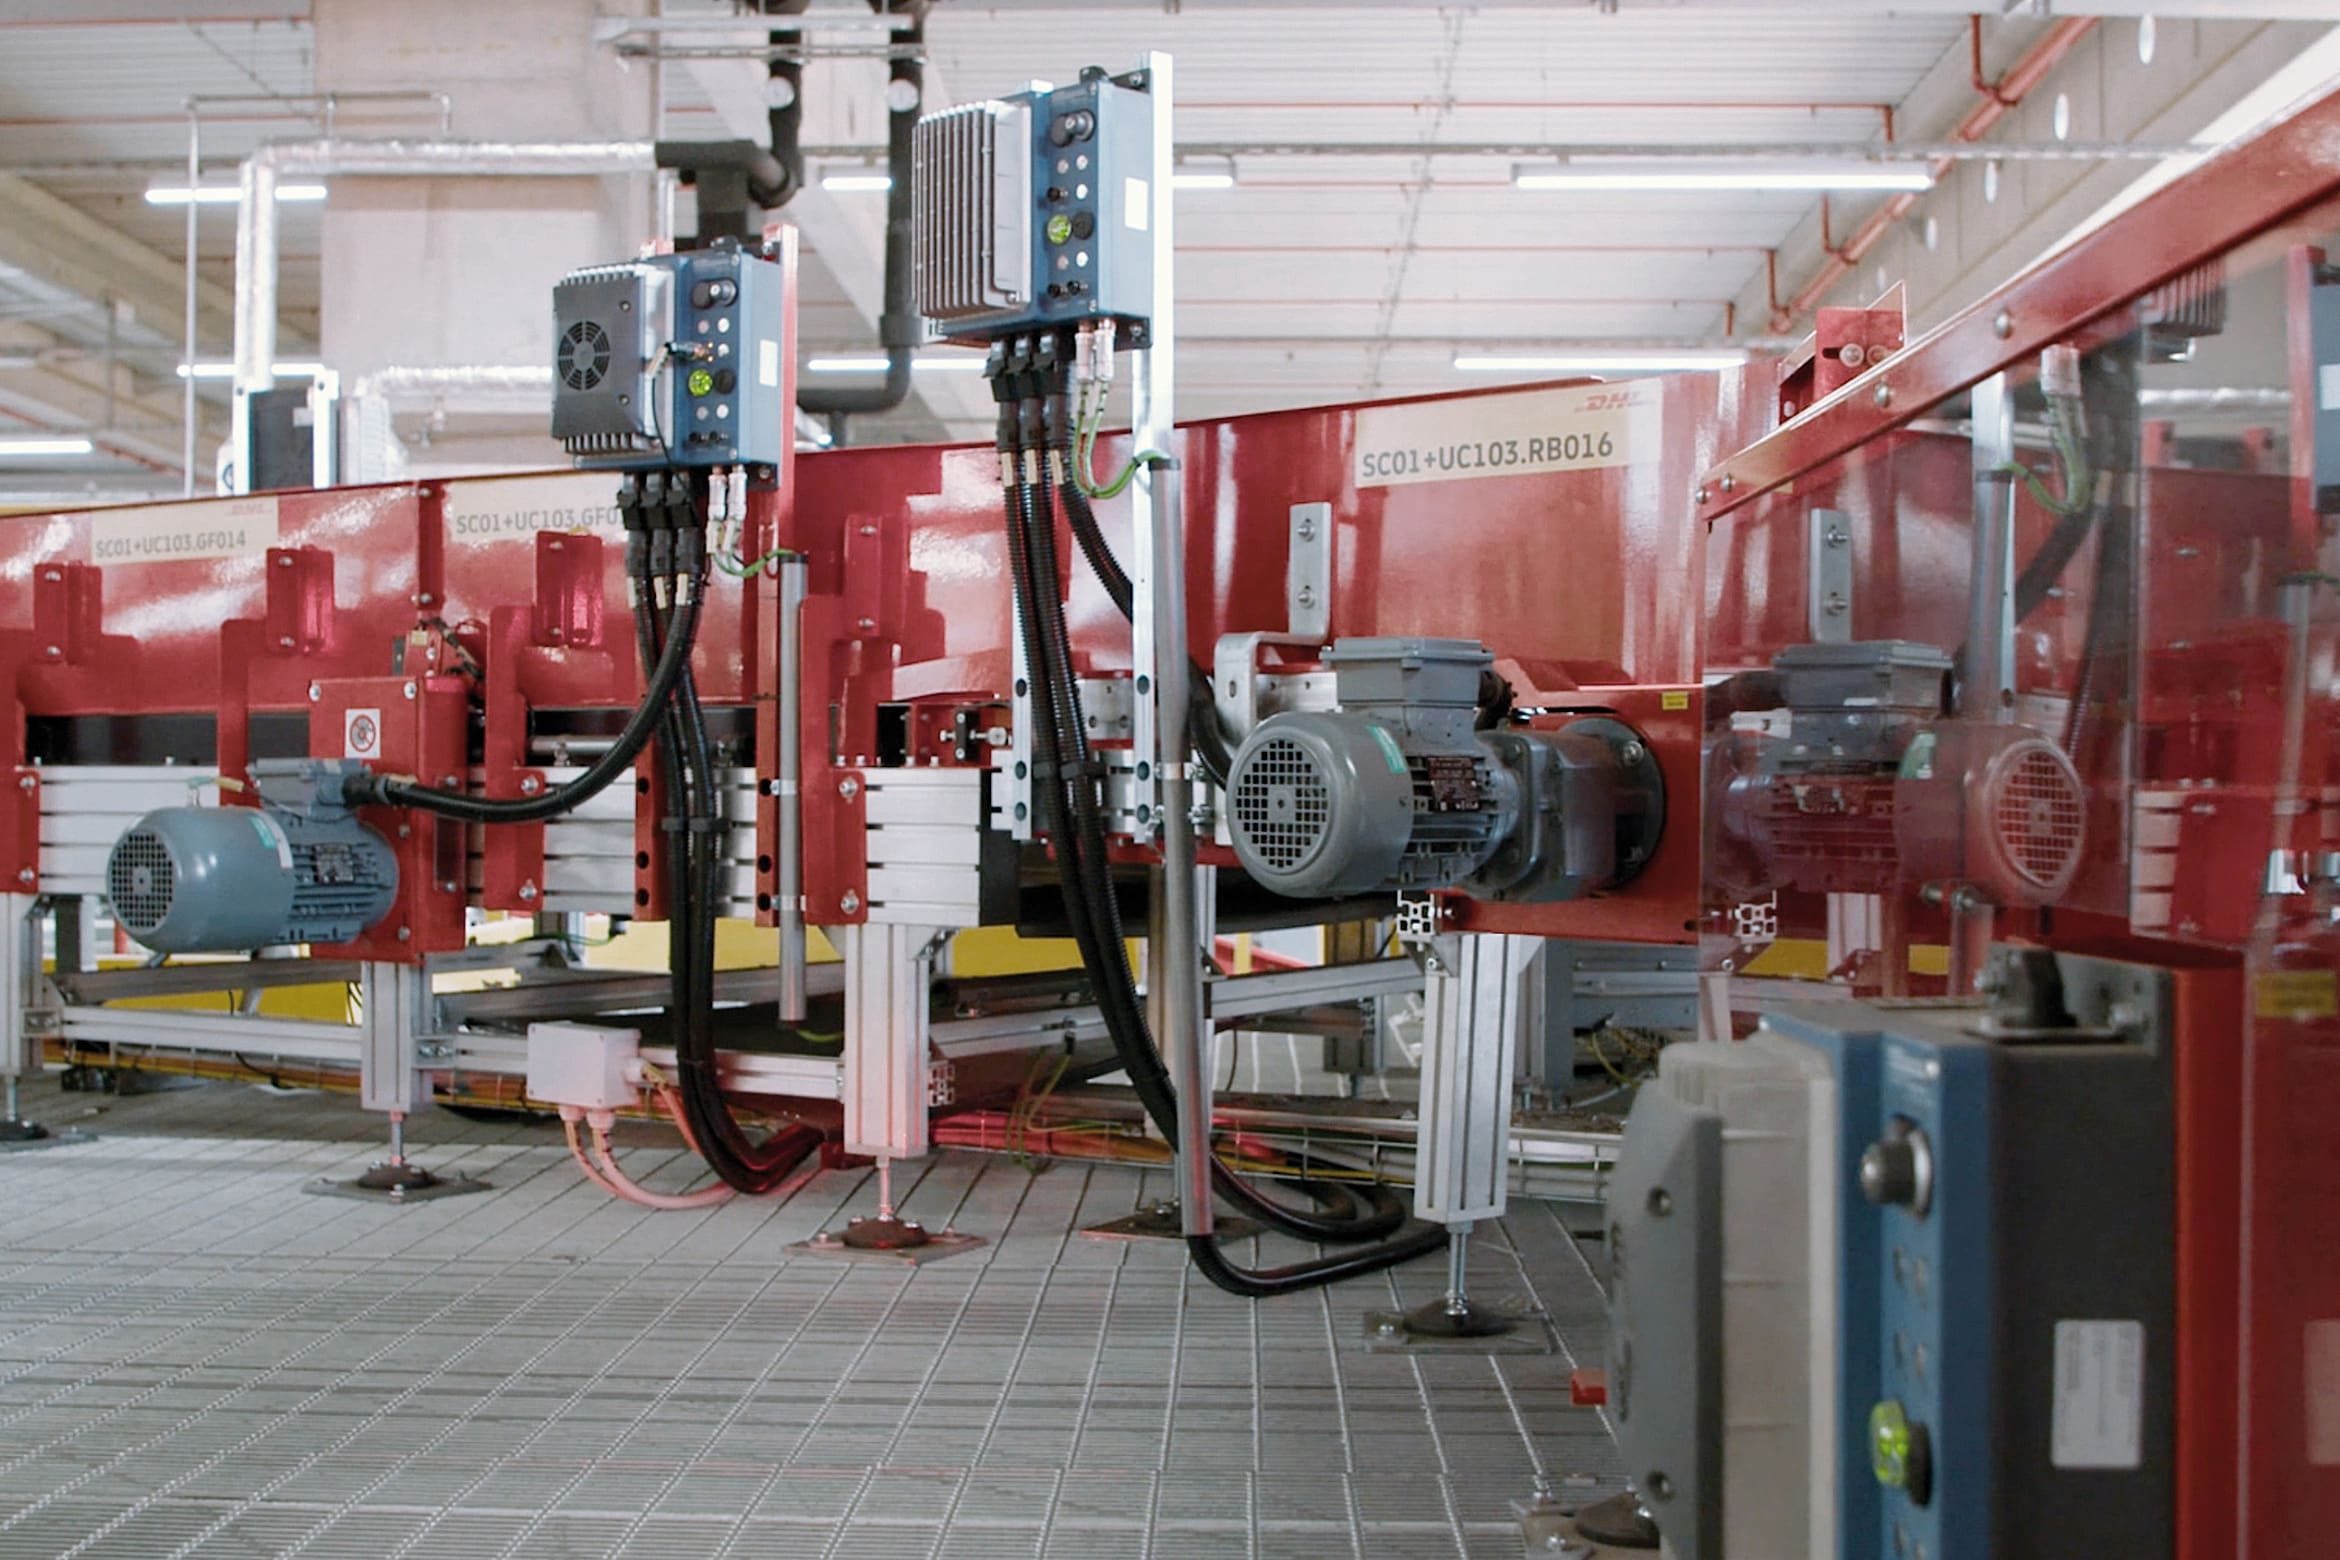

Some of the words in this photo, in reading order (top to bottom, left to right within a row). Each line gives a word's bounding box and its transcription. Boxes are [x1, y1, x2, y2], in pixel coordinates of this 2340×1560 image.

[1362, 431, 1614, 478] SC01+UC103.RB016
[455, 506, 622, 534] SC01+UC103.GF0
[95, 529, 246, 558] SC01+UC103.GF014
